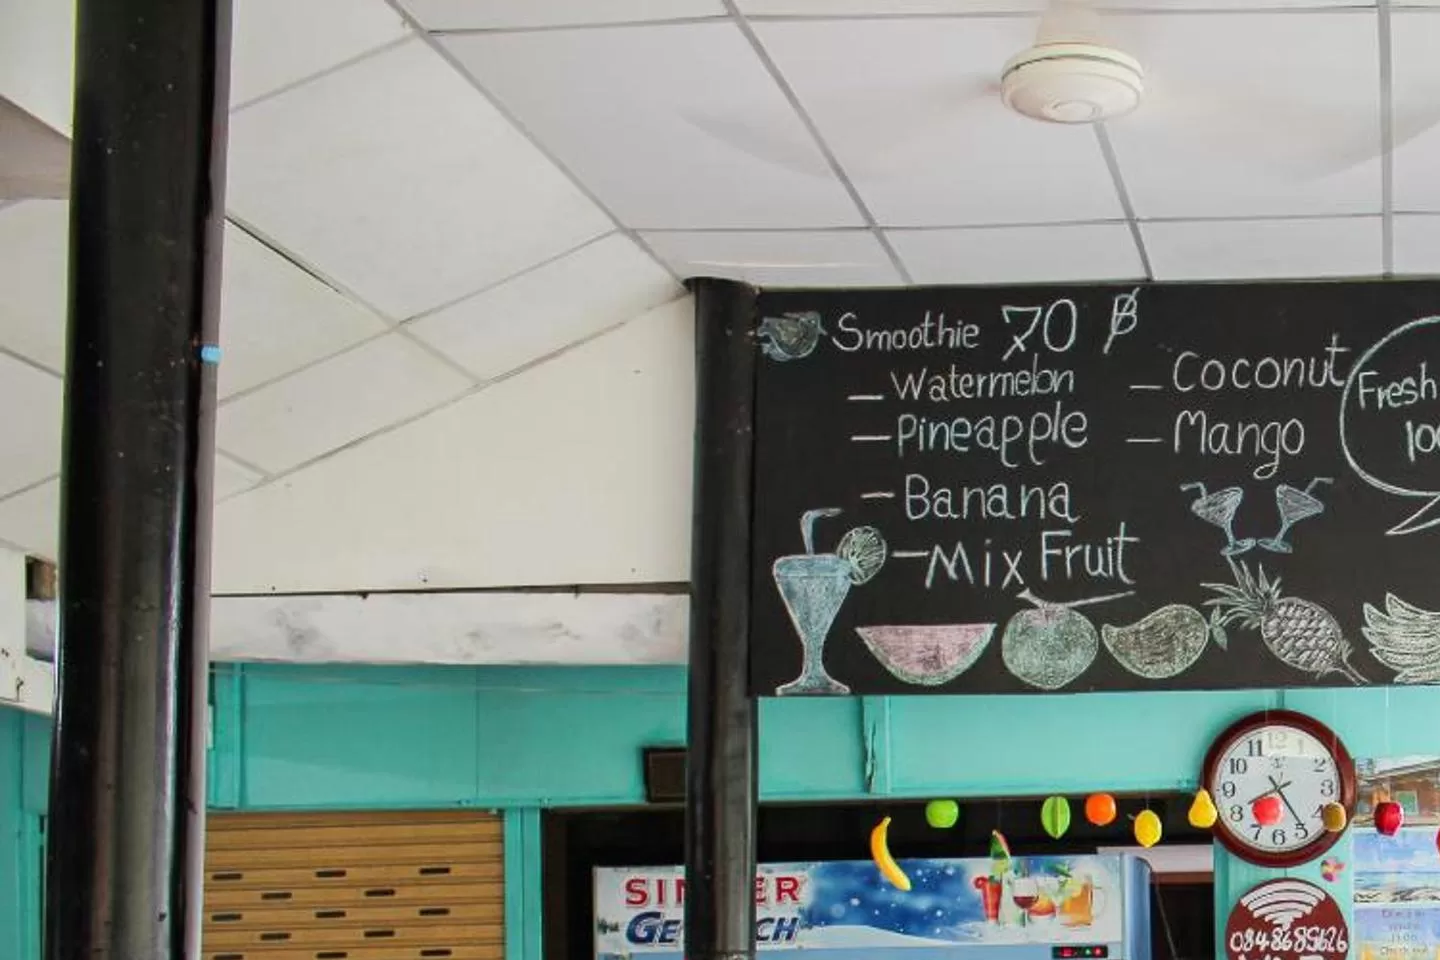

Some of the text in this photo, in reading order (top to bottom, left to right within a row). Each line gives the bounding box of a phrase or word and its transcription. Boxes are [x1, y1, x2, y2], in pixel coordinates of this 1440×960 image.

[832, 312, 980, 353] Smoothie
[1002, 299, 1077, 361] 70
[1173, 334, 1349, 393] Coconut
[891, 354, 1074, 401] Watermelon
[1358, 362, 1437, 411] Fresh
[897, 401, 1088, 467] Pineapple
[1174, 410, 1304, 480] Mango
[905, 474, 1079, 521] Banana
[926, 522, 1140, 588] Mix Fruit
[1248, 740, 1263, 757] 11
[1268, 732, 1287, 749] 12
[1229, 758, 1247, 775] 10
[1313, 759, 1327, 774] 2
[1222, 781, 1236, 798] 9
[1320, 779, 1334, 797] 3
[1230, 805, 1244, 822] 8
[1249, 824, 1263, 841] 7
[1272, 829, 1286, 845] 6
[1294, 822, 1309, 840] 5
